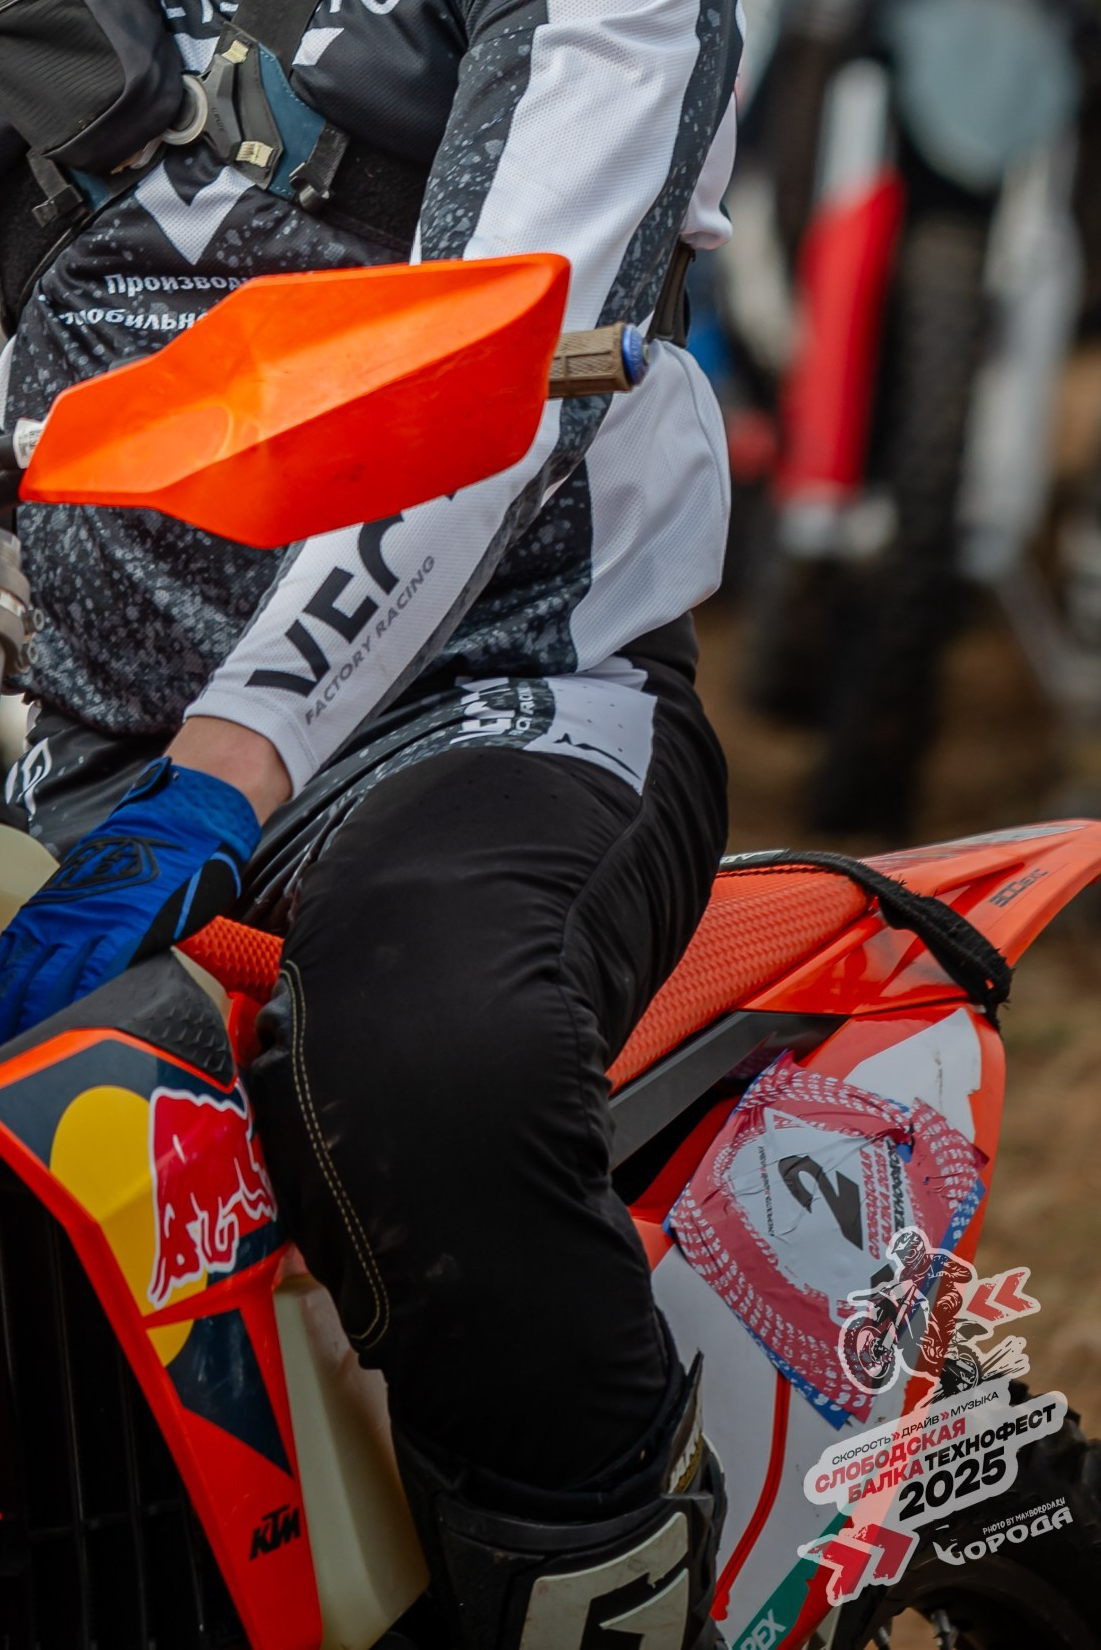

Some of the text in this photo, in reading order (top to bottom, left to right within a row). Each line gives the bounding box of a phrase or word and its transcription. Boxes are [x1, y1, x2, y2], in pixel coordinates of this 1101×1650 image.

[304, 555, 435, 726] FACTORY RACING
[778, 1155, 863, 1251] 2
[249, 1504, 301, 1561] KTM
